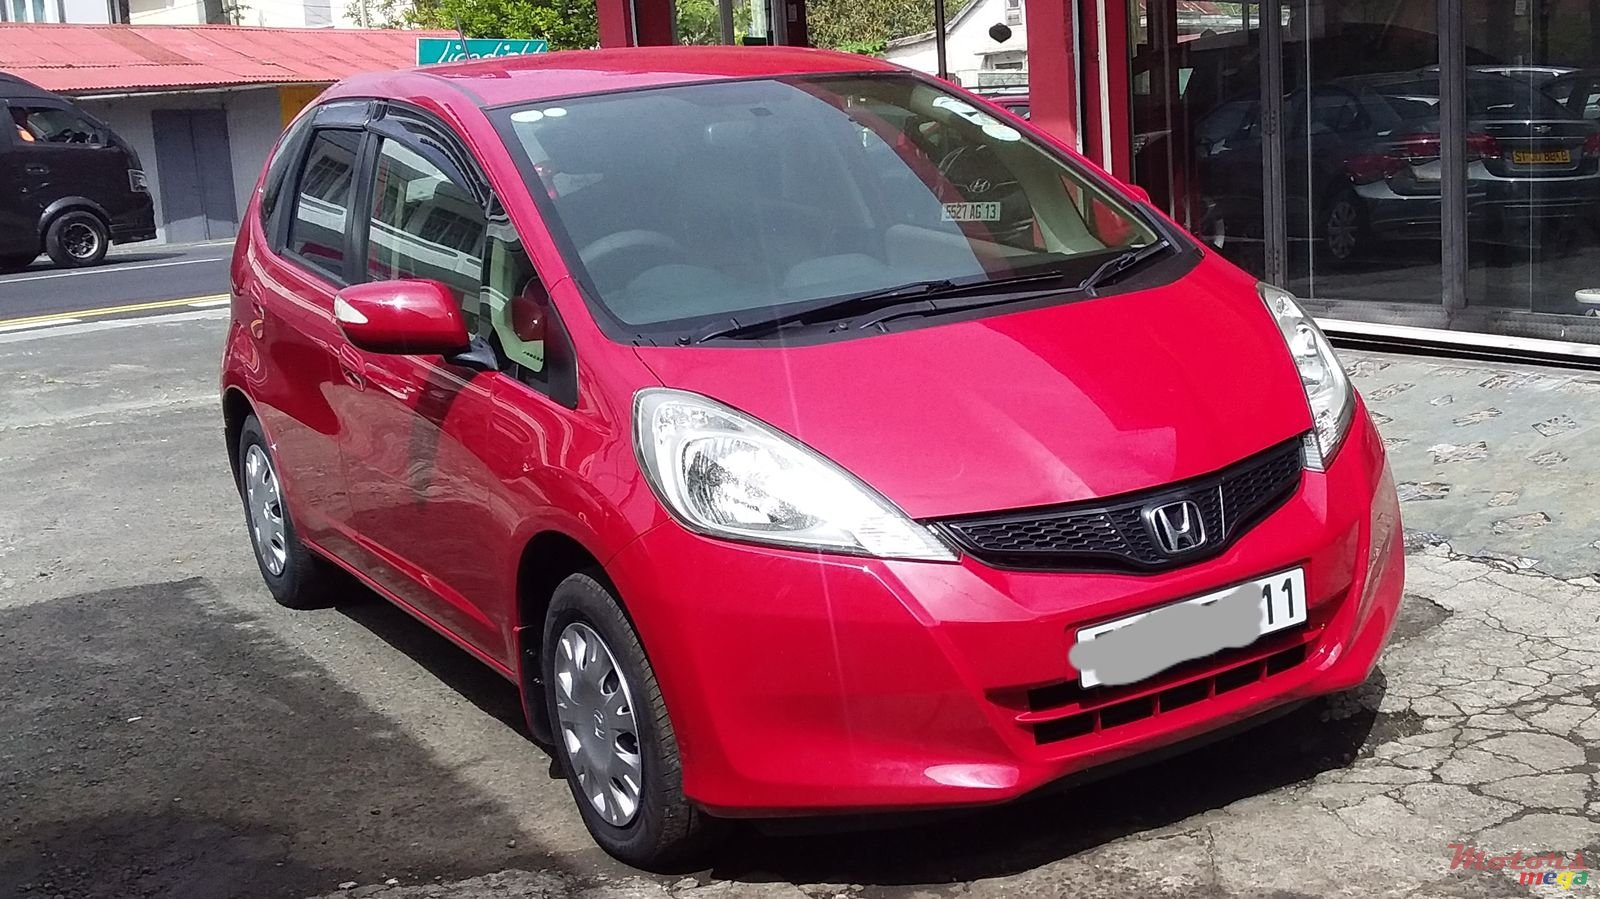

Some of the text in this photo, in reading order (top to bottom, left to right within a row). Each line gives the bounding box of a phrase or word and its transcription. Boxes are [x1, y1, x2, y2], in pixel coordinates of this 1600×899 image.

[945, 203, 996, 219] 5527 AG 13
[1262, 577, 1295, 625] 11
